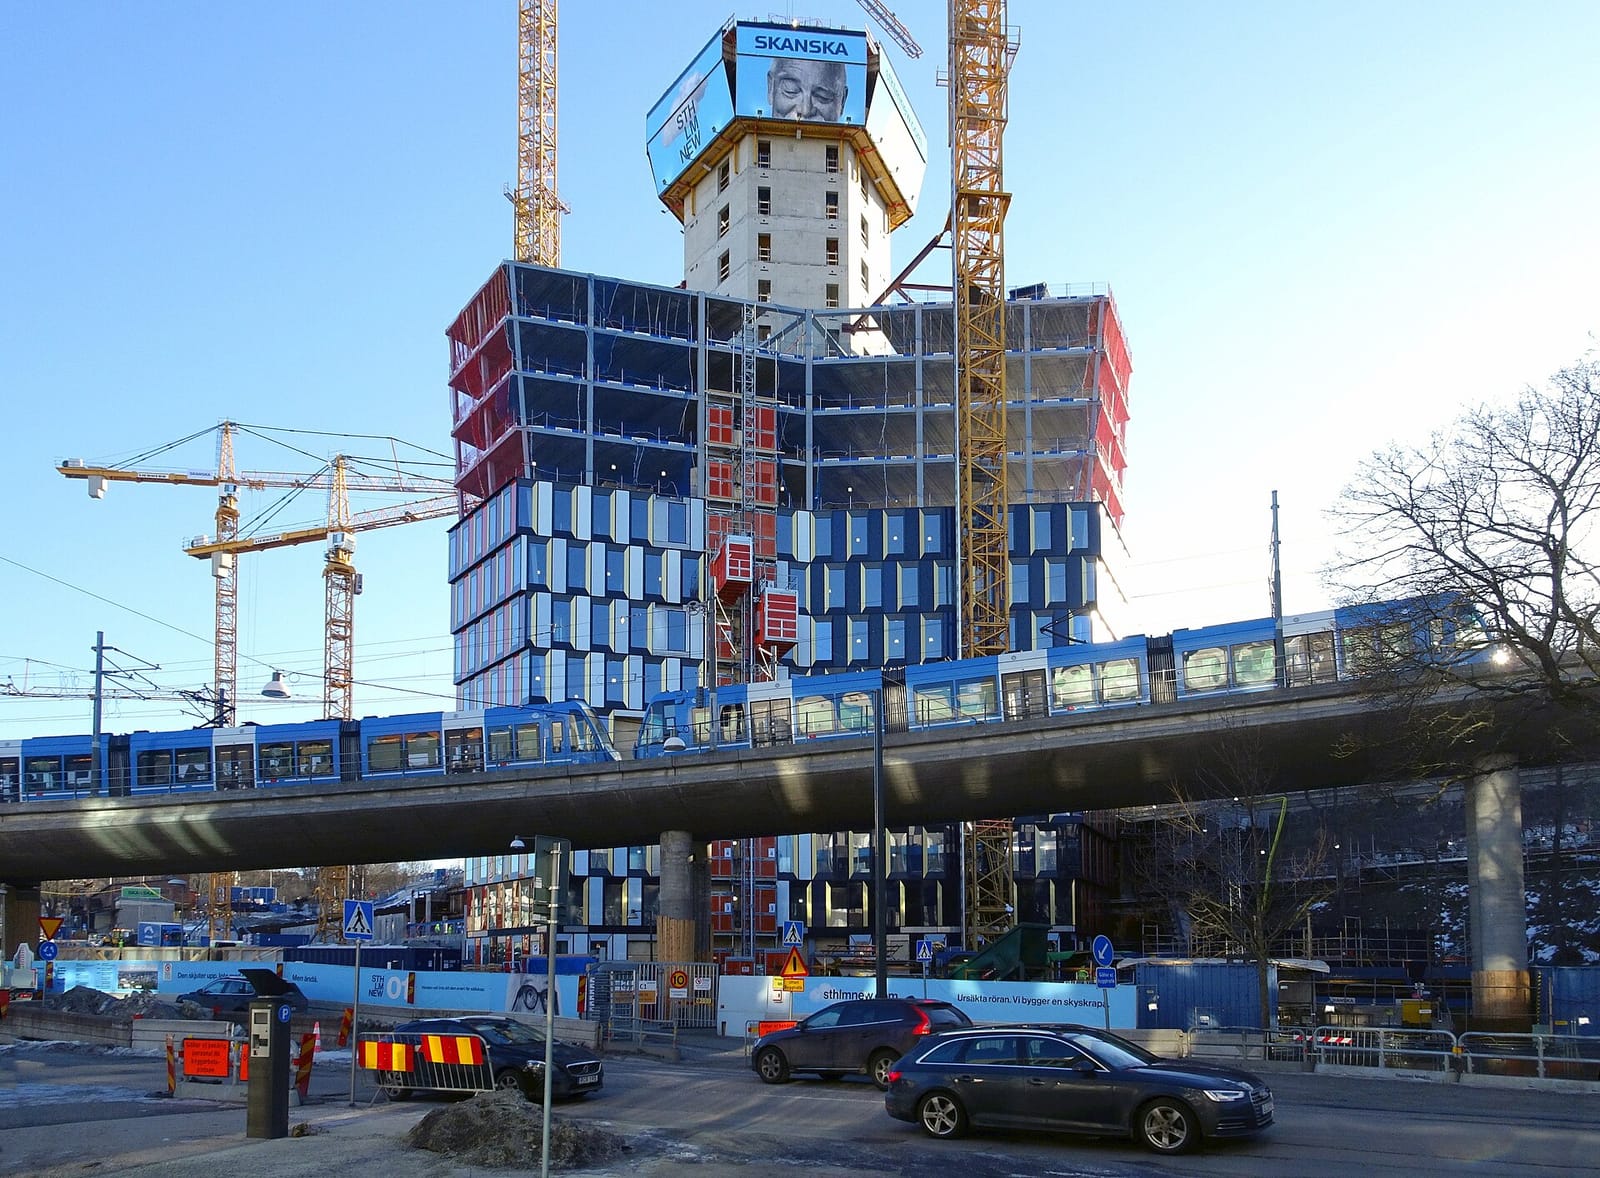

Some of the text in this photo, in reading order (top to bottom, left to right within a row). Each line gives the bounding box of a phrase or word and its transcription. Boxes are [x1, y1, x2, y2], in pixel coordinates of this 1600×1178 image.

[754, 35, 849, 57] SKANSKA
[676, 99, 696, 130] STH
[683, 114, 699, 140] LM
[679, 129, 701, 164] NEW
[673, 975, 685, 985] 10
[368, 990, 383, 998] NEW
[823, 989, 898, 1001] sthlmnew.m
[957, 993, 988, 1003] Ursäkta
[988, 995, 1011, 1004] röran.
[1012, 996, 1021, 1004] Vi
[1021, 996, 1050, 1006] bygger
[282, 1008, 289, 1020] P
